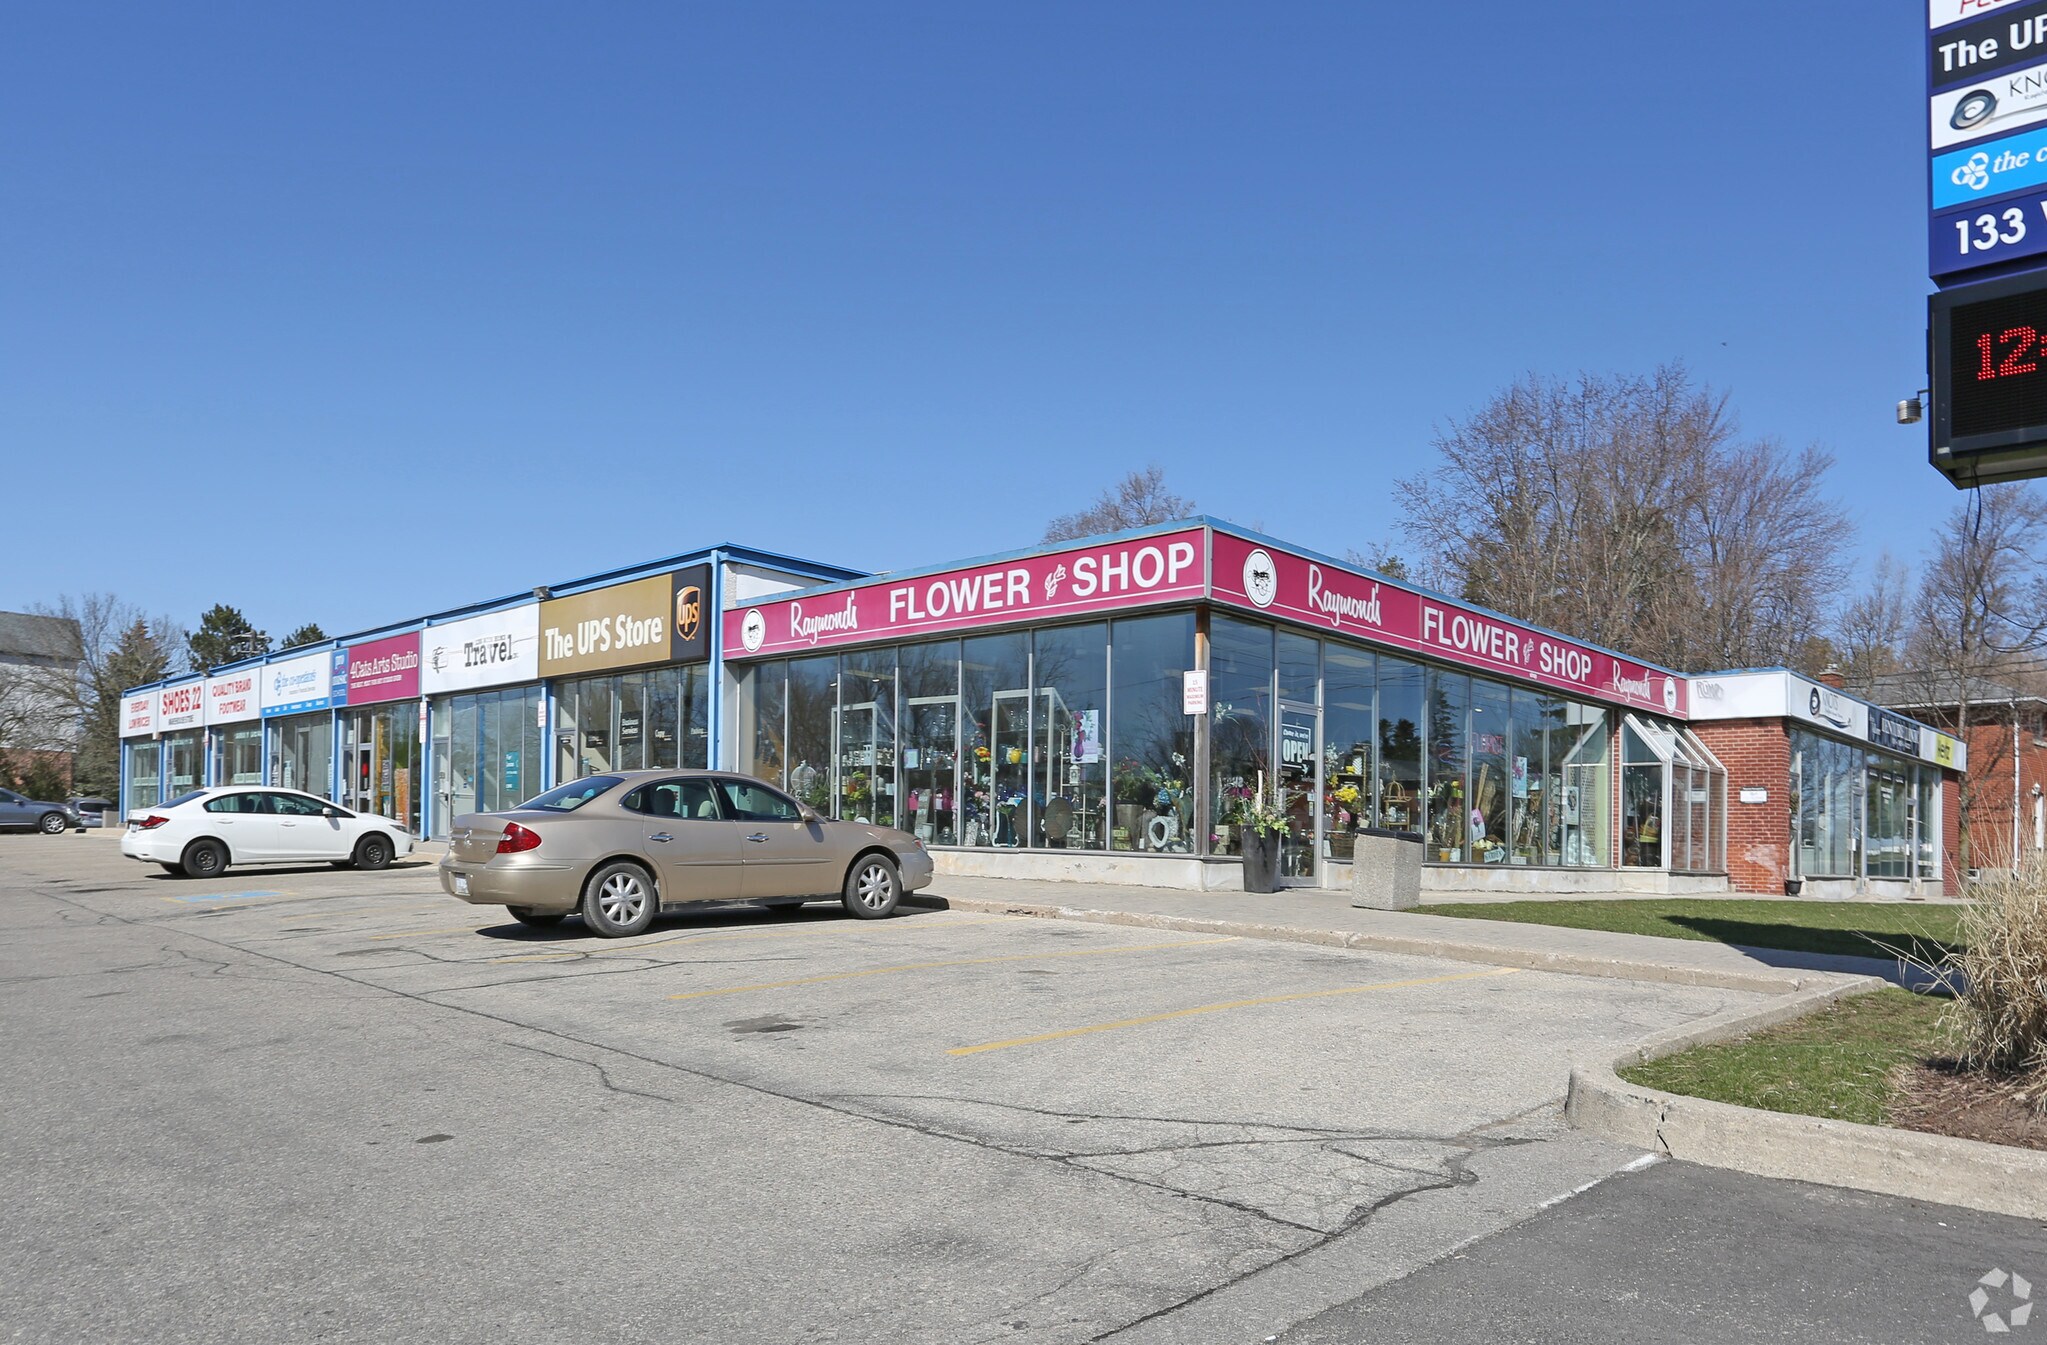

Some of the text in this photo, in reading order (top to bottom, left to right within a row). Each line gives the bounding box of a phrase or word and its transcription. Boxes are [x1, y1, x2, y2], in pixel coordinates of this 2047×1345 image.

[1938, 38, 1998, 72] The
[1992, 150, 2030, 174] the
[1955, 207, 2027, 255] 133
[790, 542, 1195, 645] Raymond's FLOWER SHOP
[678, 602, 699, 632] ups
[1308, 564, 1382, 627] Raymond's
[1423, 606, 1519, 663] FLOWER
[1539, 641, 1592, 683] SHOP
[464, 634, 512, 667] Travel
[545, 614, 662, 661] The UPS Store
[349, 651, 418, 679] 4Cats Arts Studio
[162, 686, 201, 715] SHOES 22
[213, 683, 235, 697] QUALITY
[219, 699, 246, 715] FOOTWEAR
[1283, 739, 1309, 763] OPEN
